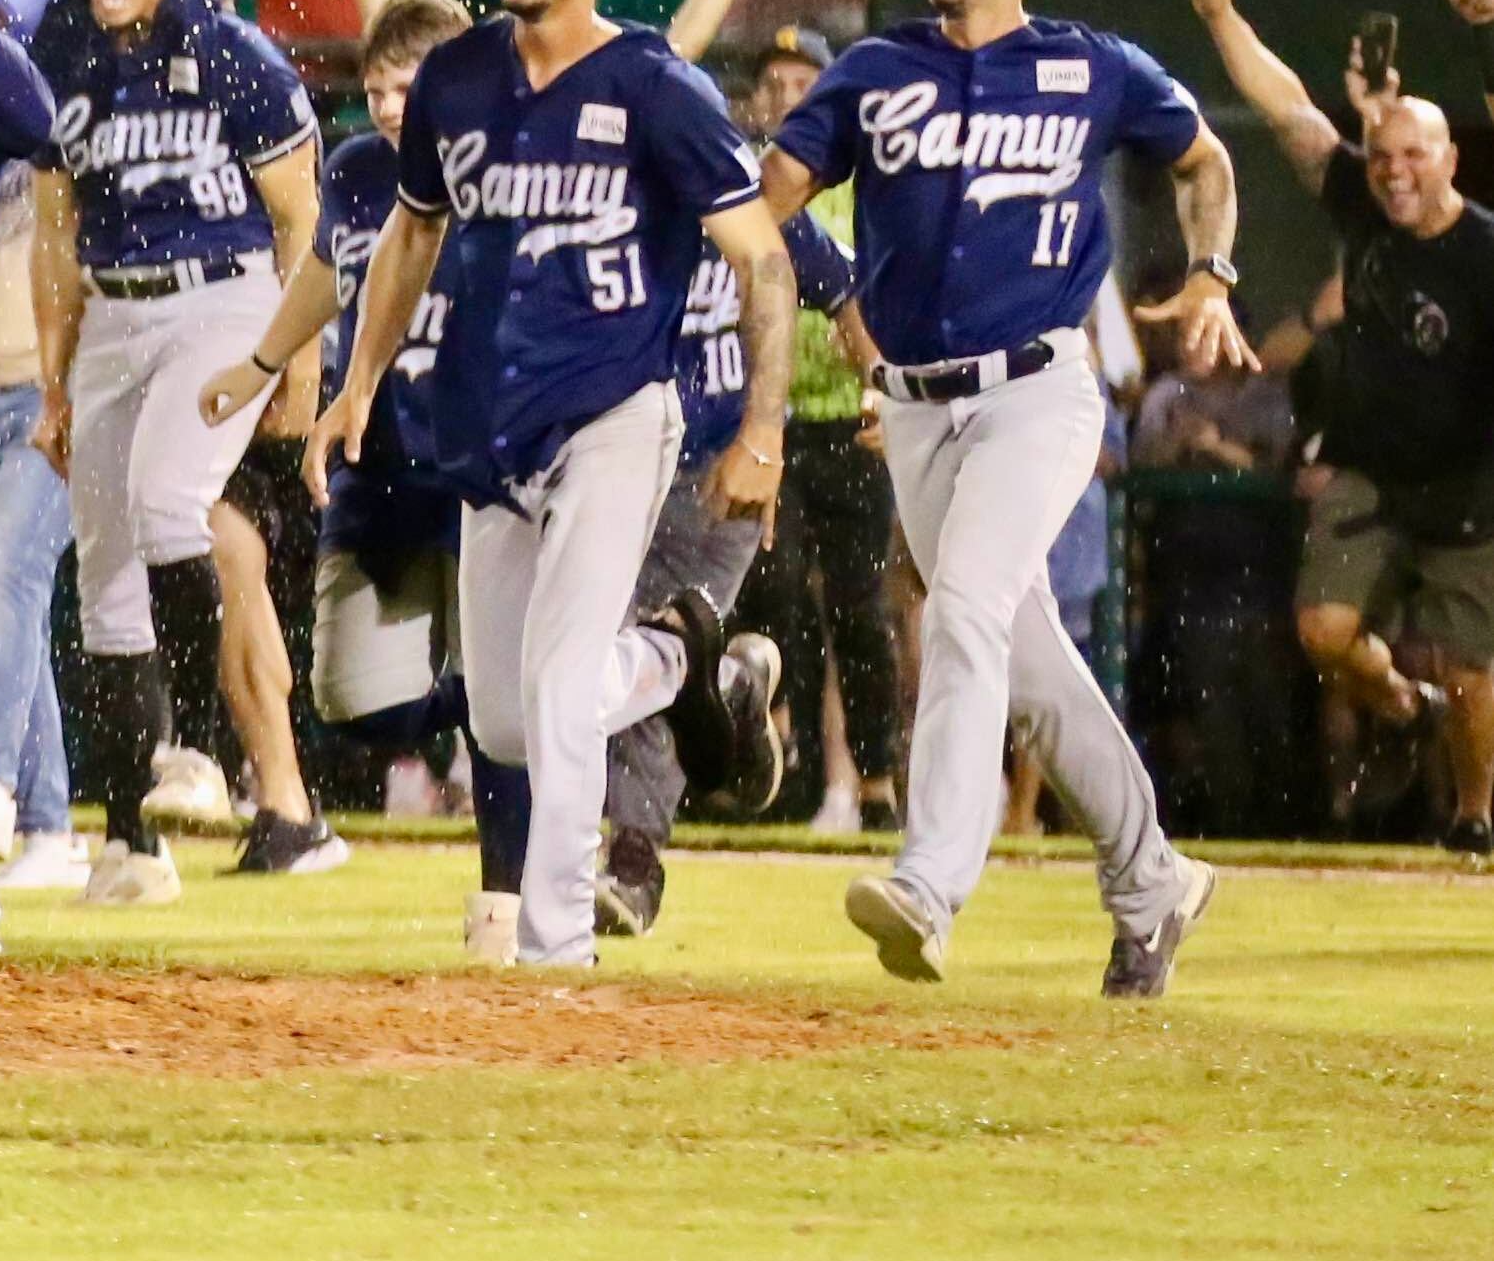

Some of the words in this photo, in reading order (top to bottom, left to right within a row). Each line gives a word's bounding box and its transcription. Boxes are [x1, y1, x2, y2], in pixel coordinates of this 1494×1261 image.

[49, 94, 230, 198] Camuy
[859, 80, 1091, 215] Camuy
[189, 161, 248, 222] 99
[436, 129, 638, 267] Camuy
[1031, 200, 1081, 267] 17
[585, 242, 648, 312] 51
[702, 331, 744, 396] 10
